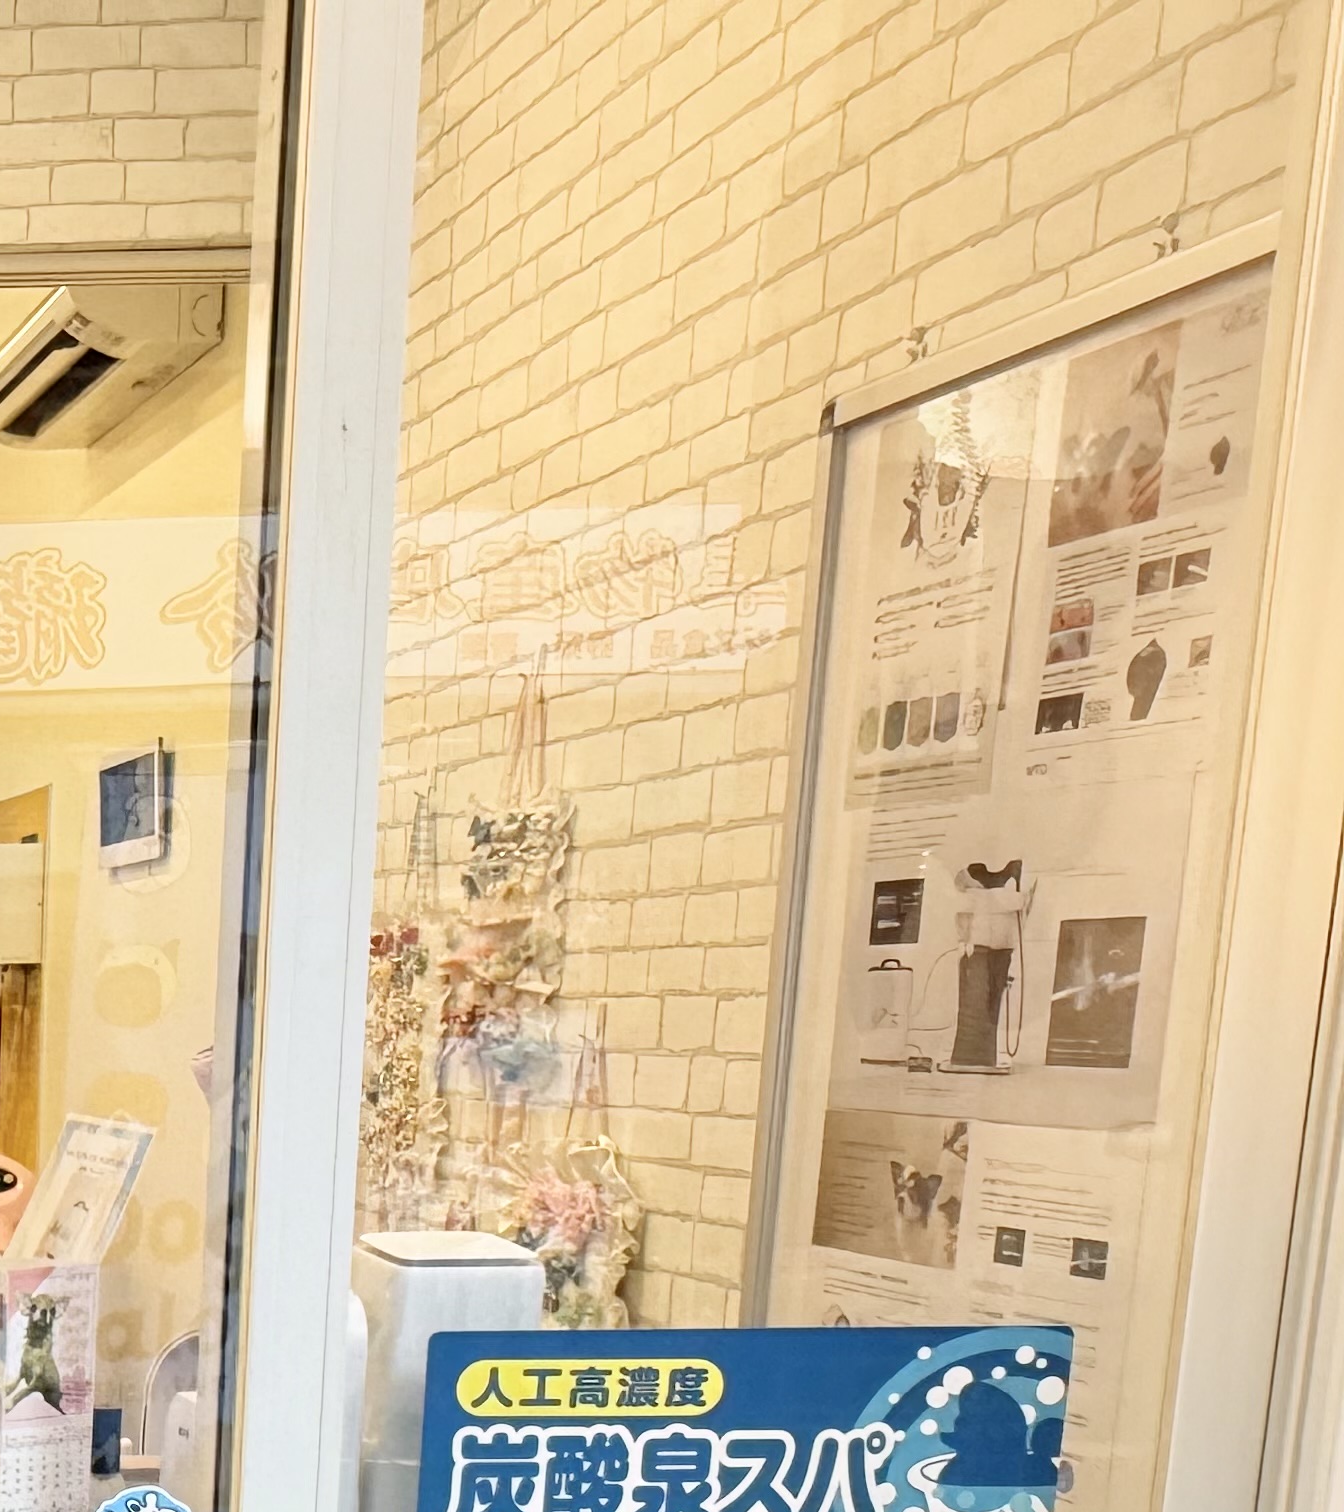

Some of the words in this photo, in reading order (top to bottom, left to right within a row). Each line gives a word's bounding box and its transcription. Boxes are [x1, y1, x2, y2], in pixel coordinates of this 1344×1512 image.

[470, 1366, 711, 1408] 人工高濃度
